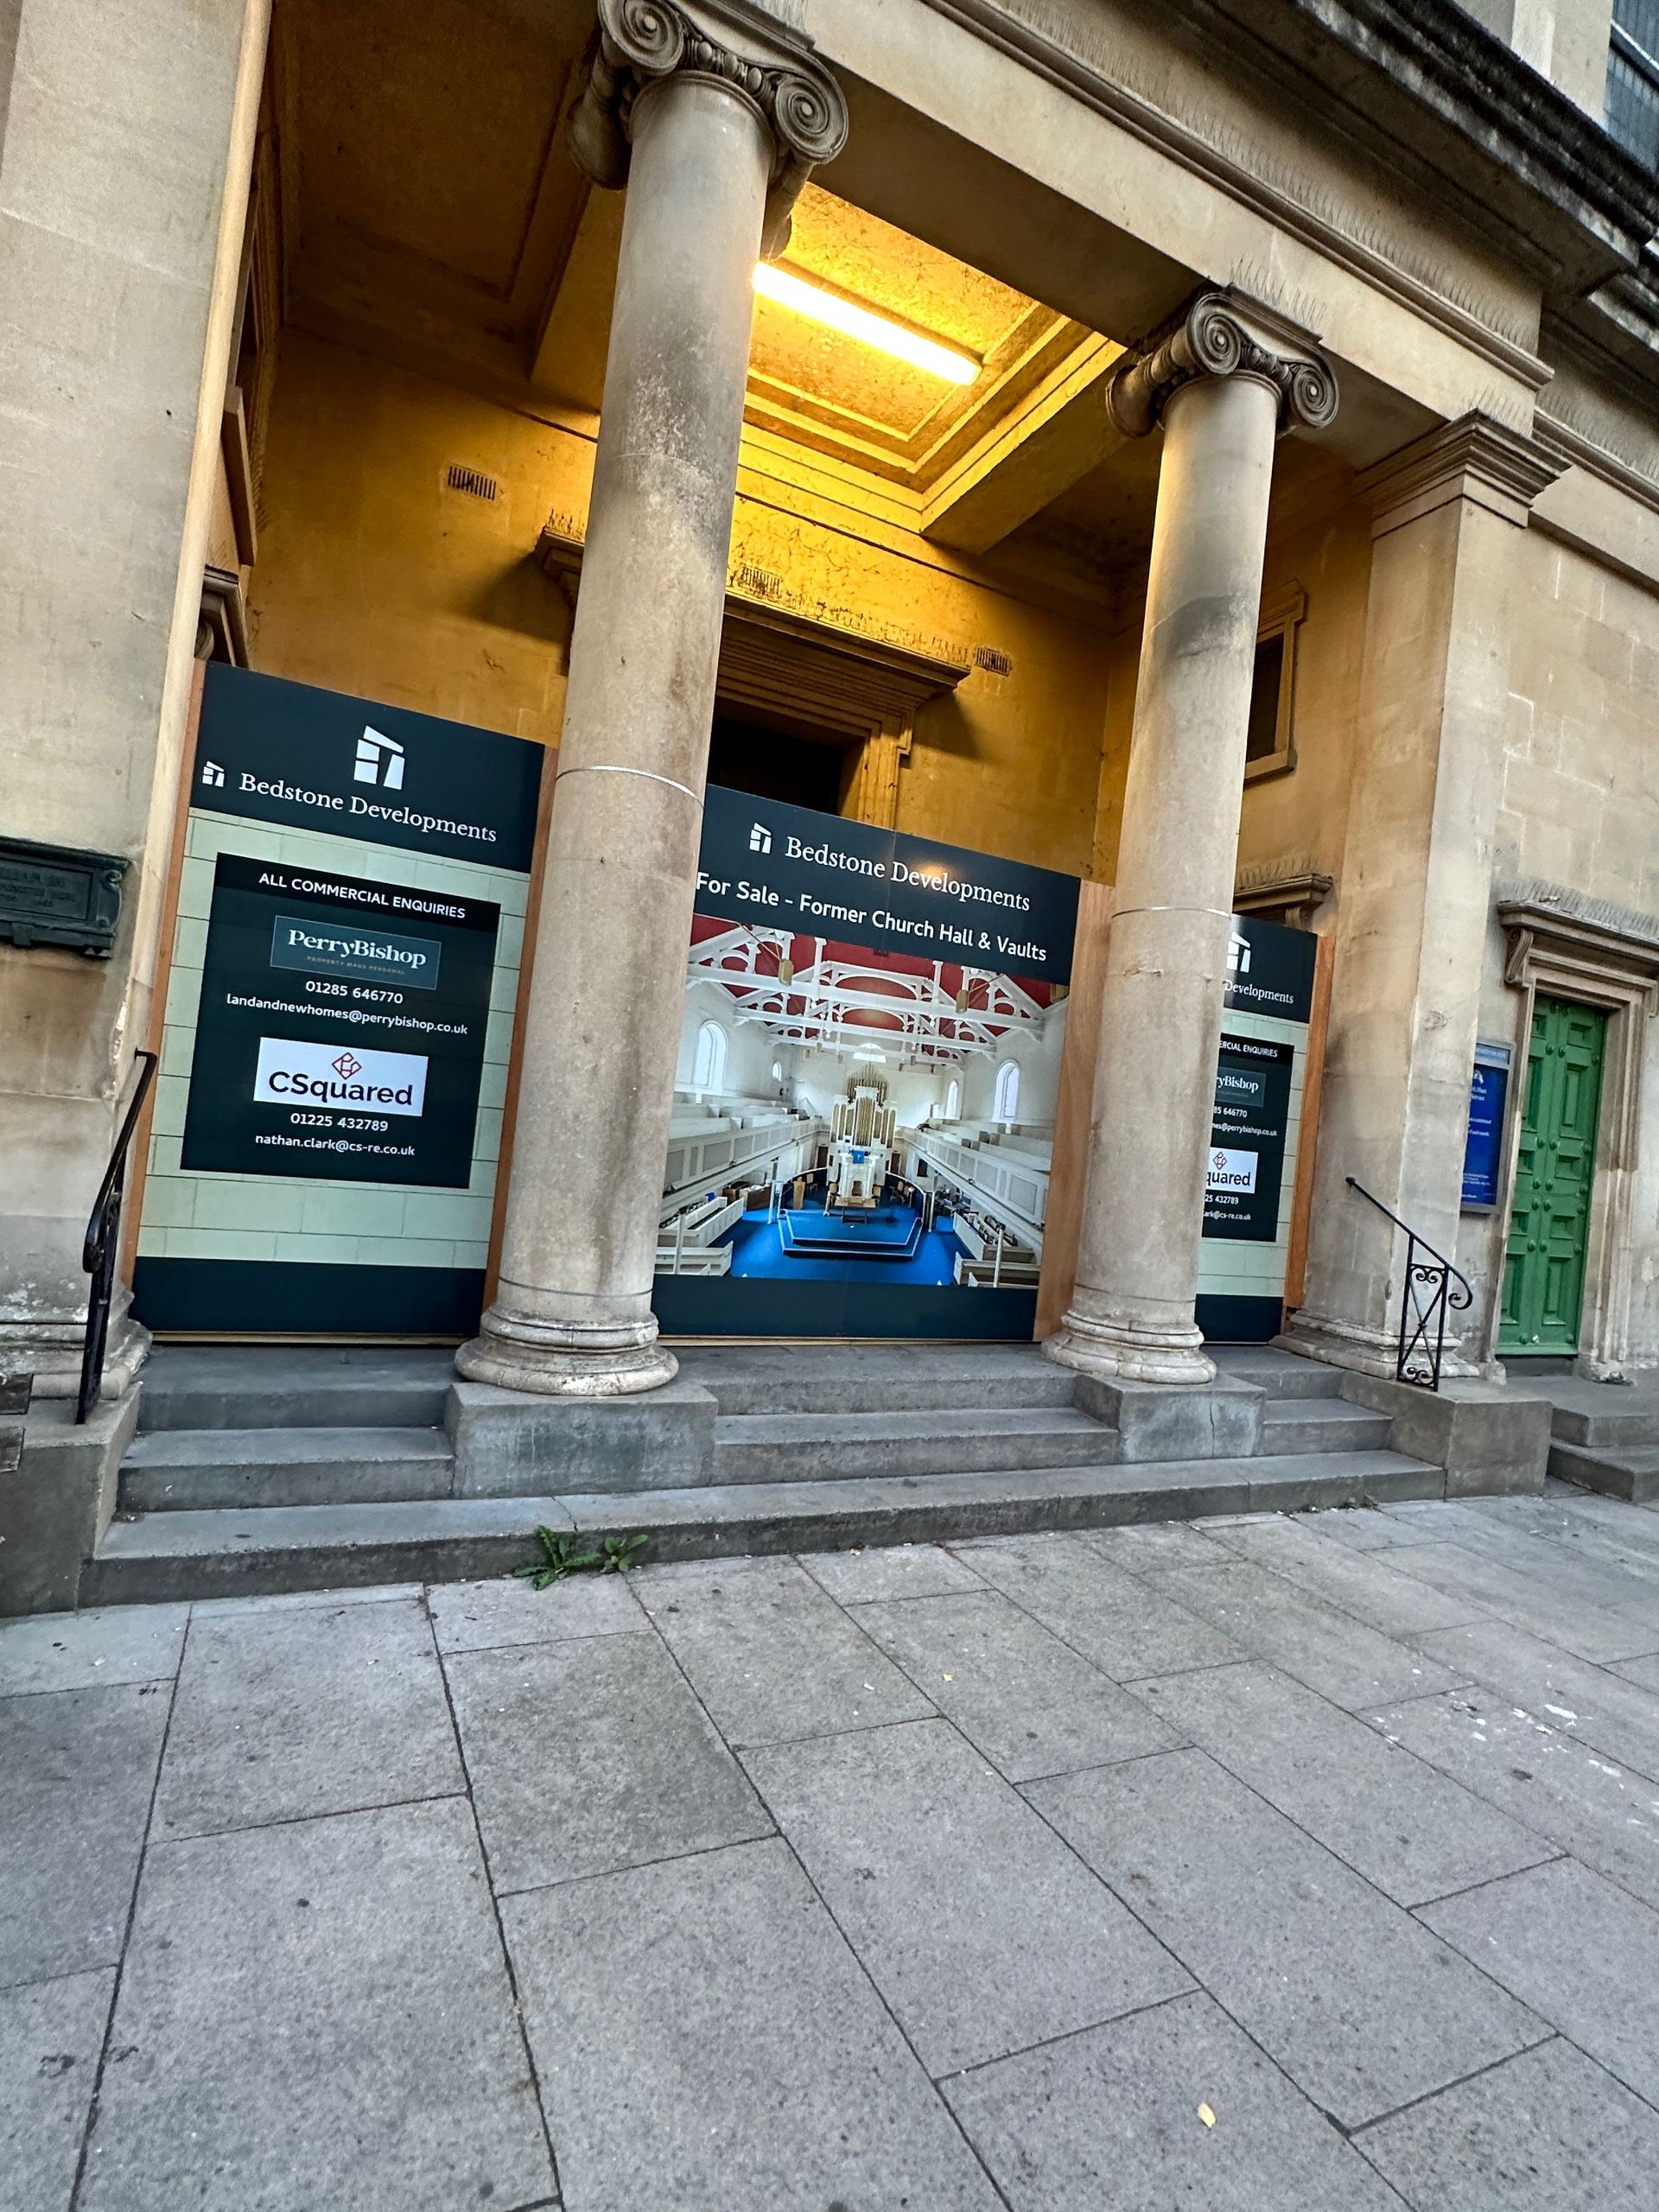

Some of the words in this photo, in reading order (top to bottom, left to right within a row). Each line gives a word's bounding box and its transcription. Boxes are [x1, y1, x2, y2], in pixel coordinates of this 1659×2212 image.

[239, 773, 344, 810] Bedstone
[349, 796, 498, 843] Developments
[785, 836, 886, 878] Bedstone
[890, 861, 1031, 912] Developments
[258, 873, 288, 888] ALL
[291, 878, 389, 906] COMMERCIAL
[392, 896, 466, 918] ENQUIRIES
[696, 872, 731, 895] For
[736, 881, 779, 906] Sale
[799, 893, 868, 924] Former
[872, 911, 934, 938] Church
[939, 924, 974, 947] Hall
[978, 932, 991, 950] &
[996, 936, 1047, 962] Vaults
[289, 929, 427, 969] PerryBishop
[305, 981, 348, 997] 01285
[353, 987, 404, 1005] 646770
[1224, 979, 1294, 1004] Developments
[226, 993, 468, 1035] landandnewhomes@perrybishop.co.uk
[1219, 1039, 1242, 1052] ERCIAL
[1243, 1045, 1279, 1058] ENQUIRIES
[269, 1071, 413, 1106] CSquared
[290, 1113, 334, 1127] 01225
[337, 1117, 389, 1132] 432789
[255, 1134, 416, 1156] nathan.clark@cs-re.co.uk
